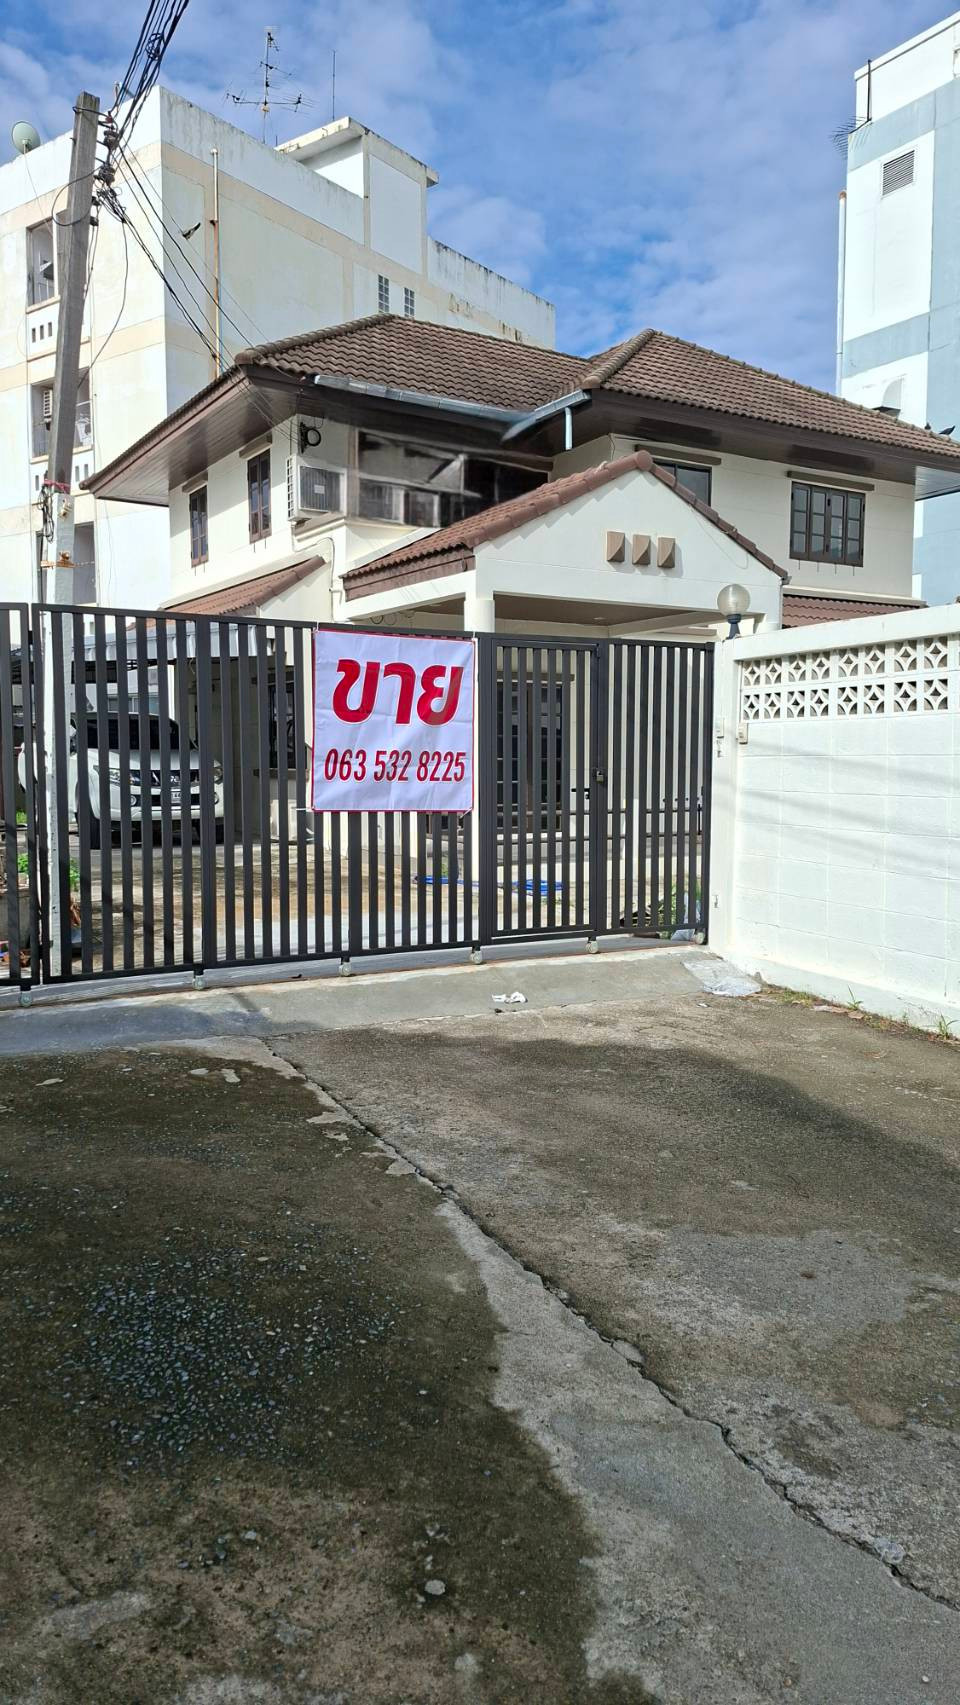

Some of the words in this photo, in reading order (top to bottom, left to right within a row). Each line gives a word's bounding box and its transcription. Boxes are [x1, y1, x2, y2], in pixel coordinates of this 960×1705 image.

[332, 658, 465, 726] ขาย
[324, 748, 367, 782] 063
[373, 749, 412, 782] 532
[416, 750, 467, 782] 8225
